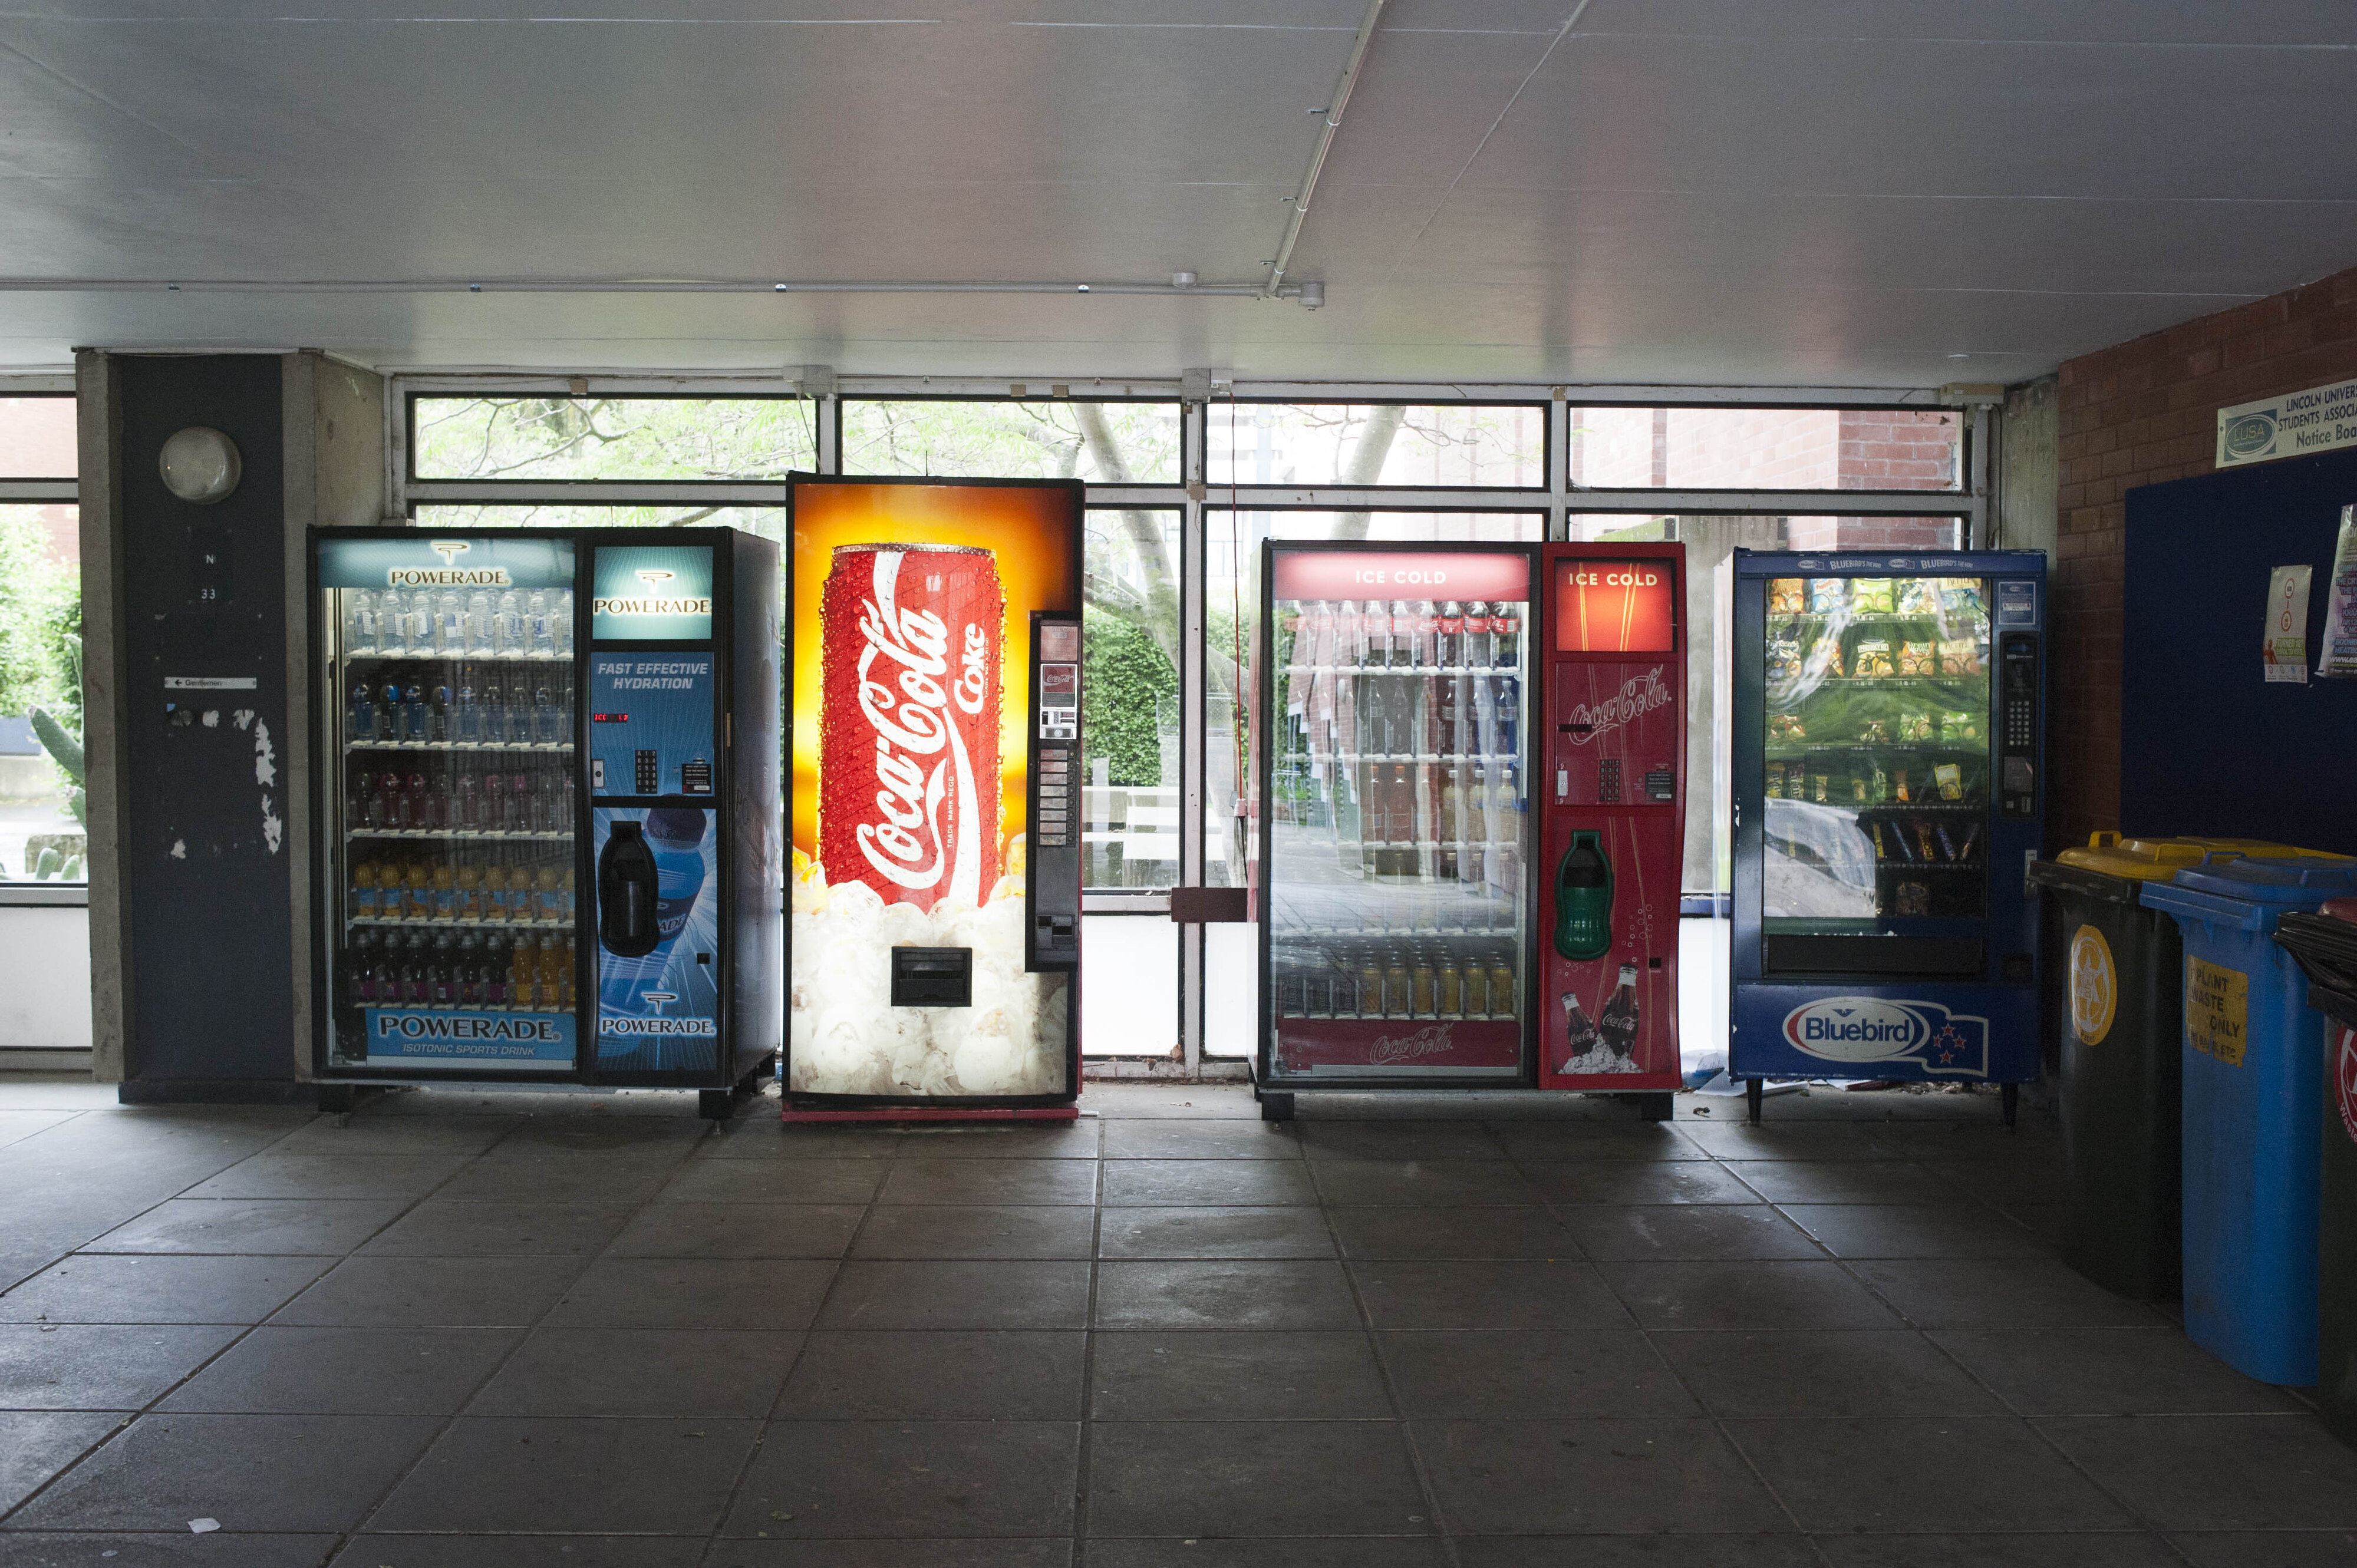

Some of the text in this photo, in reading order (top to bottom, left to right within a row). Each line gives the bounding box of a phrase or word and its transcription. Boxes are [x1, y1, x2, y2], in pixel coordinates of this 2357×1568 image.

[2287, 393, 2321, 412] LINCOLN
[2279, 411, 2319, 431] STUDENTS
[2235, 423, 2264, 441] LUSA
[2296, 429, 2330, 448] Notice
[206, 554, 214, 564] N
[1829, 560, 1865, 570] BLUEBIRD'S
[1921, 559, 1957, 570] BLUEBIRD'S
[392, 570, 505, 585] POWERADE
[1356, 570, 1447, 584] ICE COLD
[1570, 573, 1657, 586] ICE COLD
[201, 589, 216, 599] 33
[594, 599, 710, 613] POWERADE
[598, 662, 708, 675] FAST EFFECTIVE
[954, 623, 985, 714] Coke
[614, 678, 693, 689] HYDRATION
[2197, 965, 2229, 992] PLANT
[2191, 987, 2224, 1012] WASTE
[380, 1016, 553, 1040] POWERADE
[602, 1019, 711, 1034] POWERADE
[1603, 1014, 1639, 1031] Coca-Cola
[1806, 1018, 1910, 1042] Bluebird
[2210, 1015, 2239, 1038] ONLY
[403, 1044, 535, 1056] ISOTONIC SPORTS DRINK
[1370, 1022, 1454, 1065] Coca-Cola
